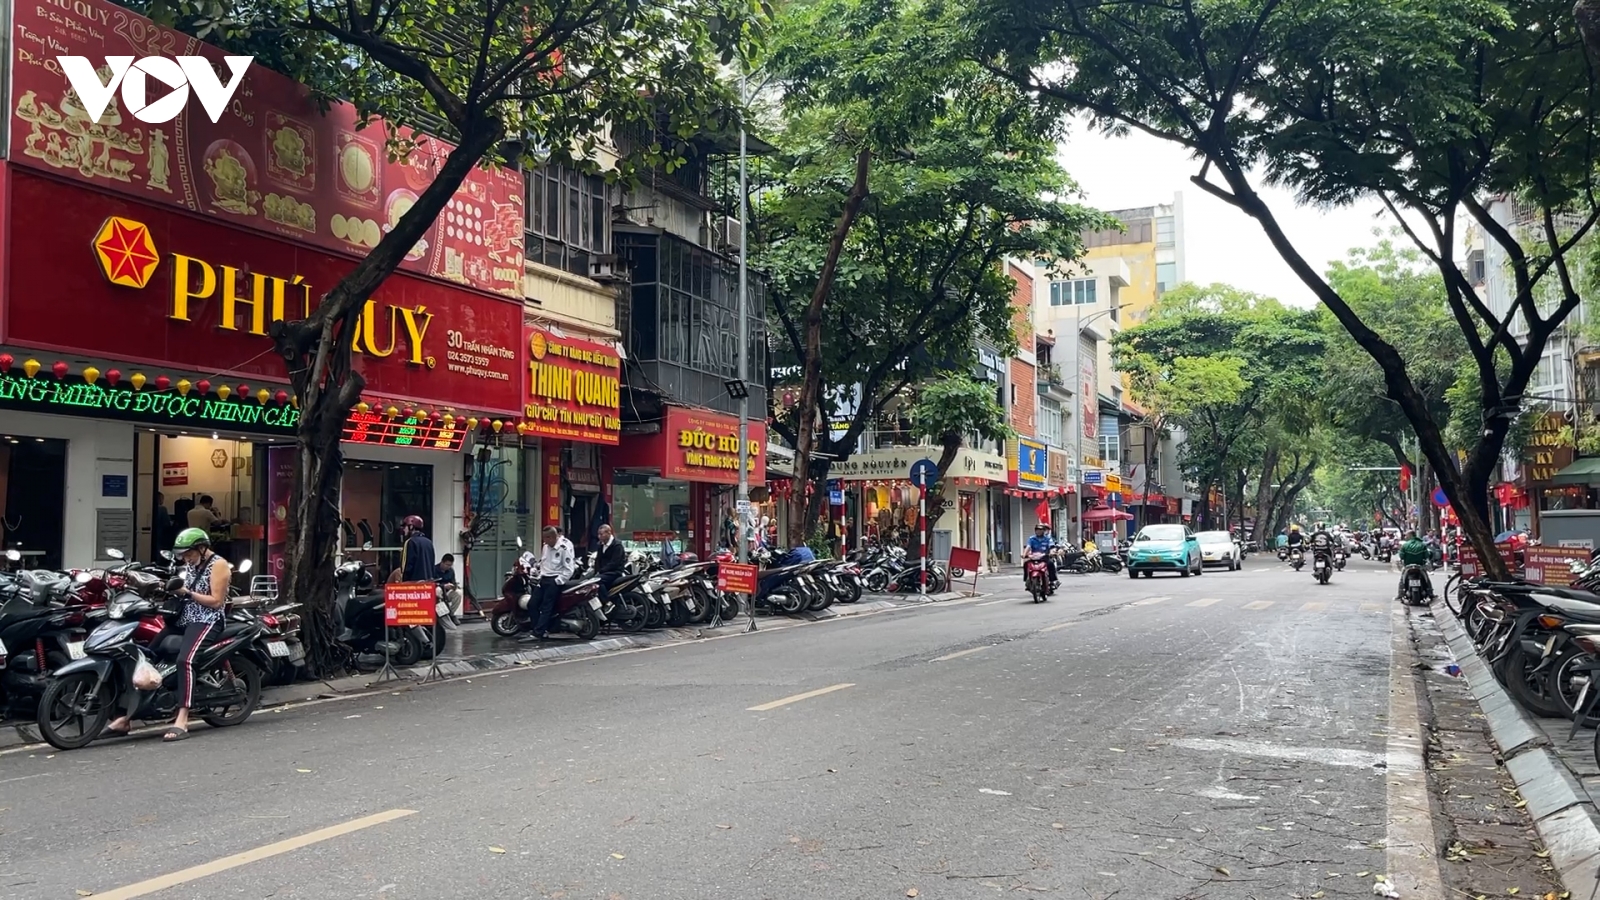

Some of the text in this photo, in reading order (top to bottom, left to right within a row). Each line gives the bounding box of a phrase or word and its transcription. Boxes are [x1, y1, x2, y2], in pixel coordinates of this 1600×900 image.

[73, 0, 176, 57] QUÝ 2022
[166, 252, 434, 364] PHÚ UÝ
[447, 329, 463, 348] 30
[481, 344, 499, 357] NHÂN
[499, 346, 515, 360] TÔNG
[447, 350, 459, 361] 024
[447, 363, 509, 381] www.phuquy.com.vn
[530, 361, 619, 409] THỊNH QUANG
[133, 389, 200, 418] ĐƯỢC
[201, 401, 263, 424] NHNN
[680, 425, 760, 456] ĐỨC HÙG
[686, 450, 702, 466] VÀNG
[703, 454, 722, 468] TRANG
[1535, 449, 1554, 464] KỲ
[407, 591, 420, 600] NHÂN
[421, 591, 431, 599] DÂN
